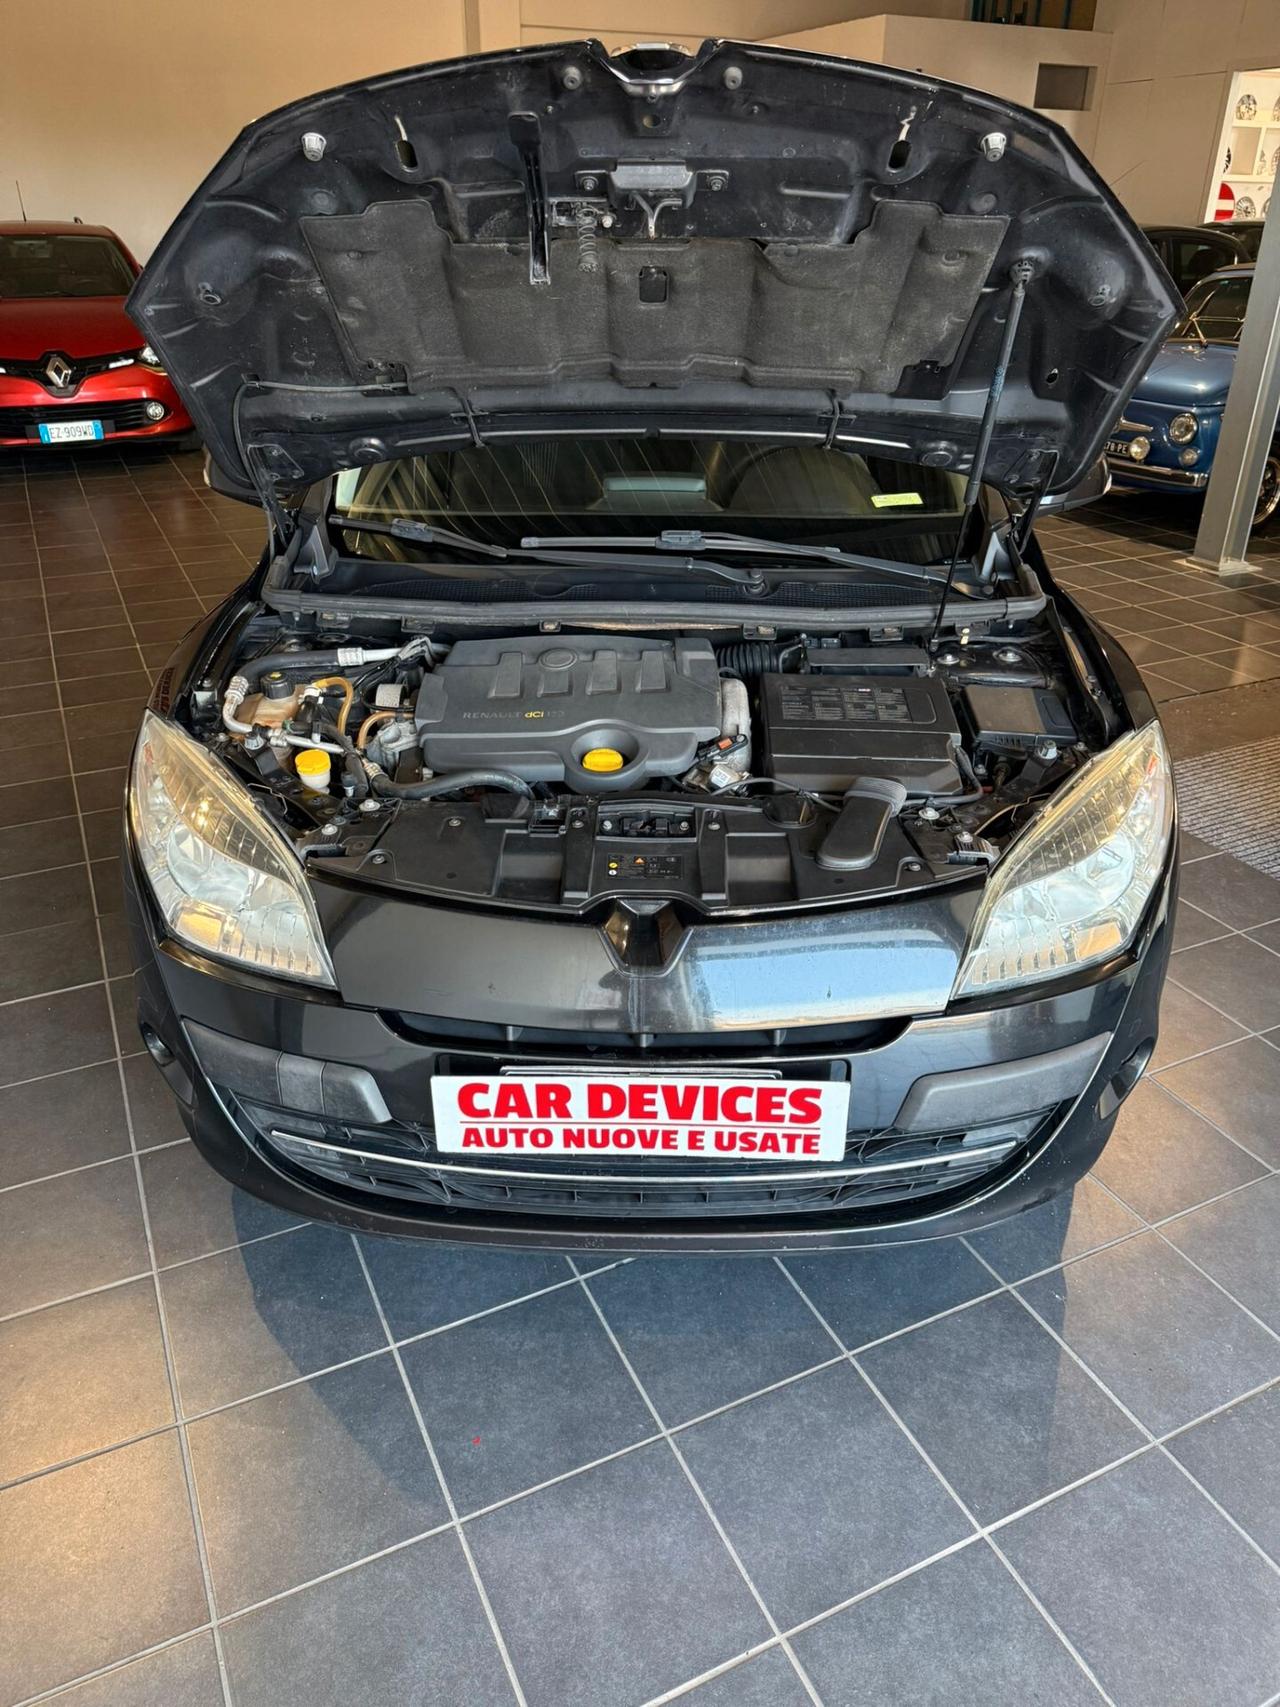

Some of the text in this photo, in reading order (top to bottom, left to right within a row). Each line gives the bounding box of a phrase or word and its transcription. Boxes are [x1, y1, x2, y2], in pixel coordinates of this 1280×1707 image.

[463, 711, 522, 719] RENAULT
[457, 1082, 822, 1125] CAR DEVICES
[462, 1127, 821, 1154] AUTO NUOVE E USATE
